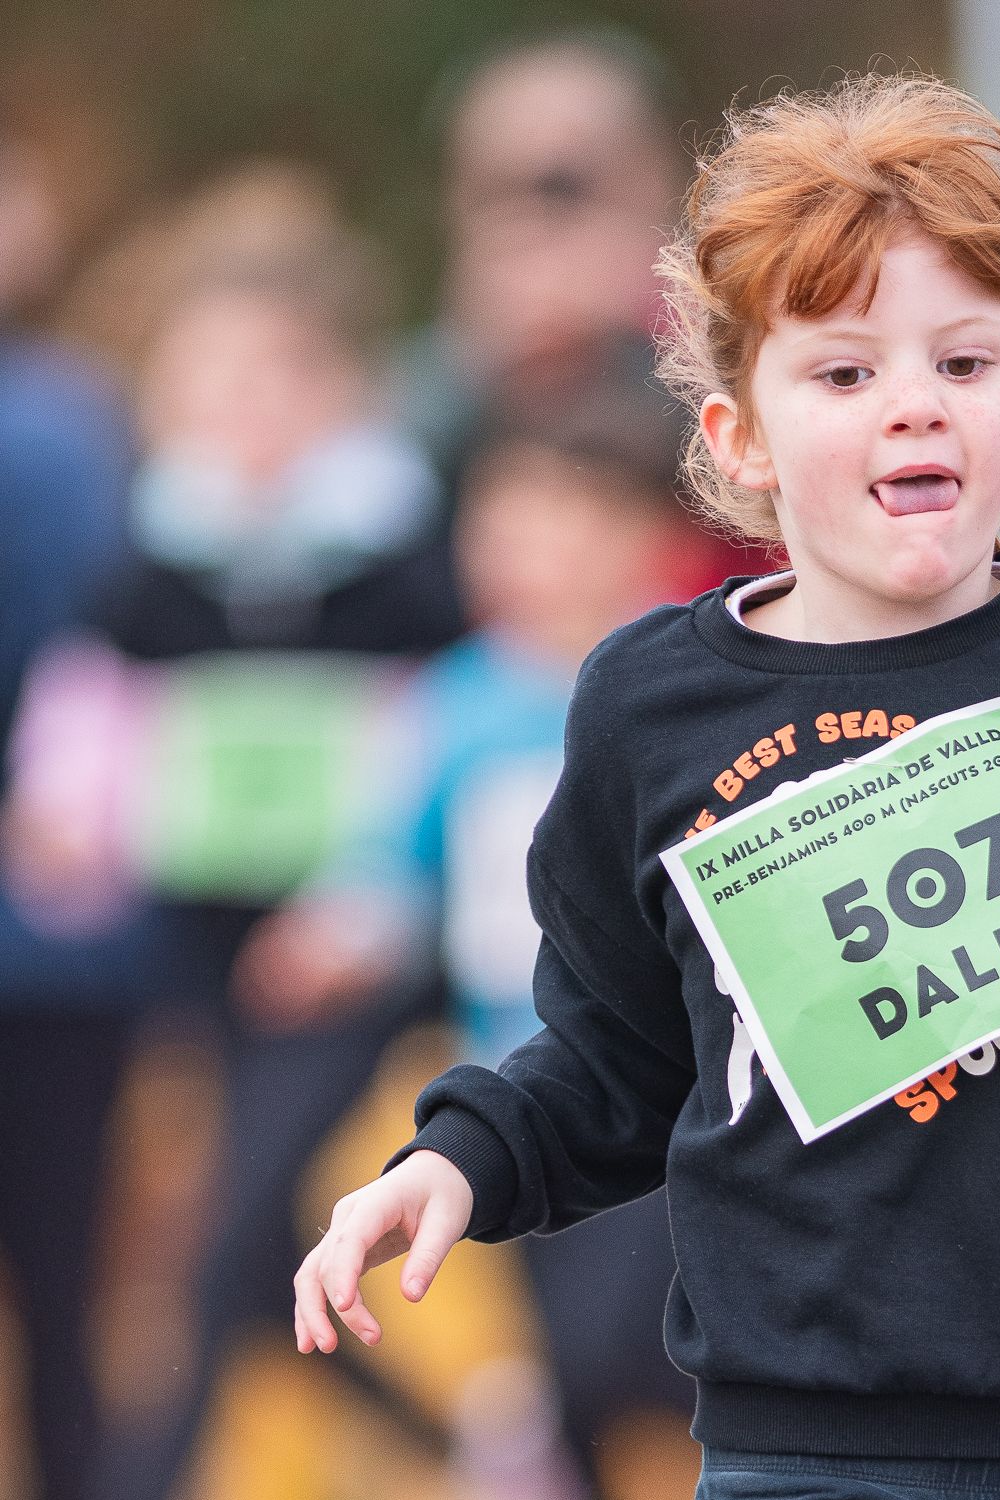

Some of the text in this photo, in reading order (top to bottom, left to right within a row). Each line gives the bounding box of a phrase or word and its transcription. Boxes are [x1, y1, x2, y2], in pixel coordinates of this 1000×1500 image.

[696, 859, 719, 881] IX
[722, 827, 784, 867] MILLA
[789, 773, 900, 832] SOLIDÀRIA
[905, 754, 934, 778] DE
[712, 723, 798, 802] BEST
[713, 832, 837, 904] PRE-BENJAMINS
[844, 814, 875, 836] 400
[881, 804, 895, 818] M
[901, 766, 979, 813] (NASCUTS
